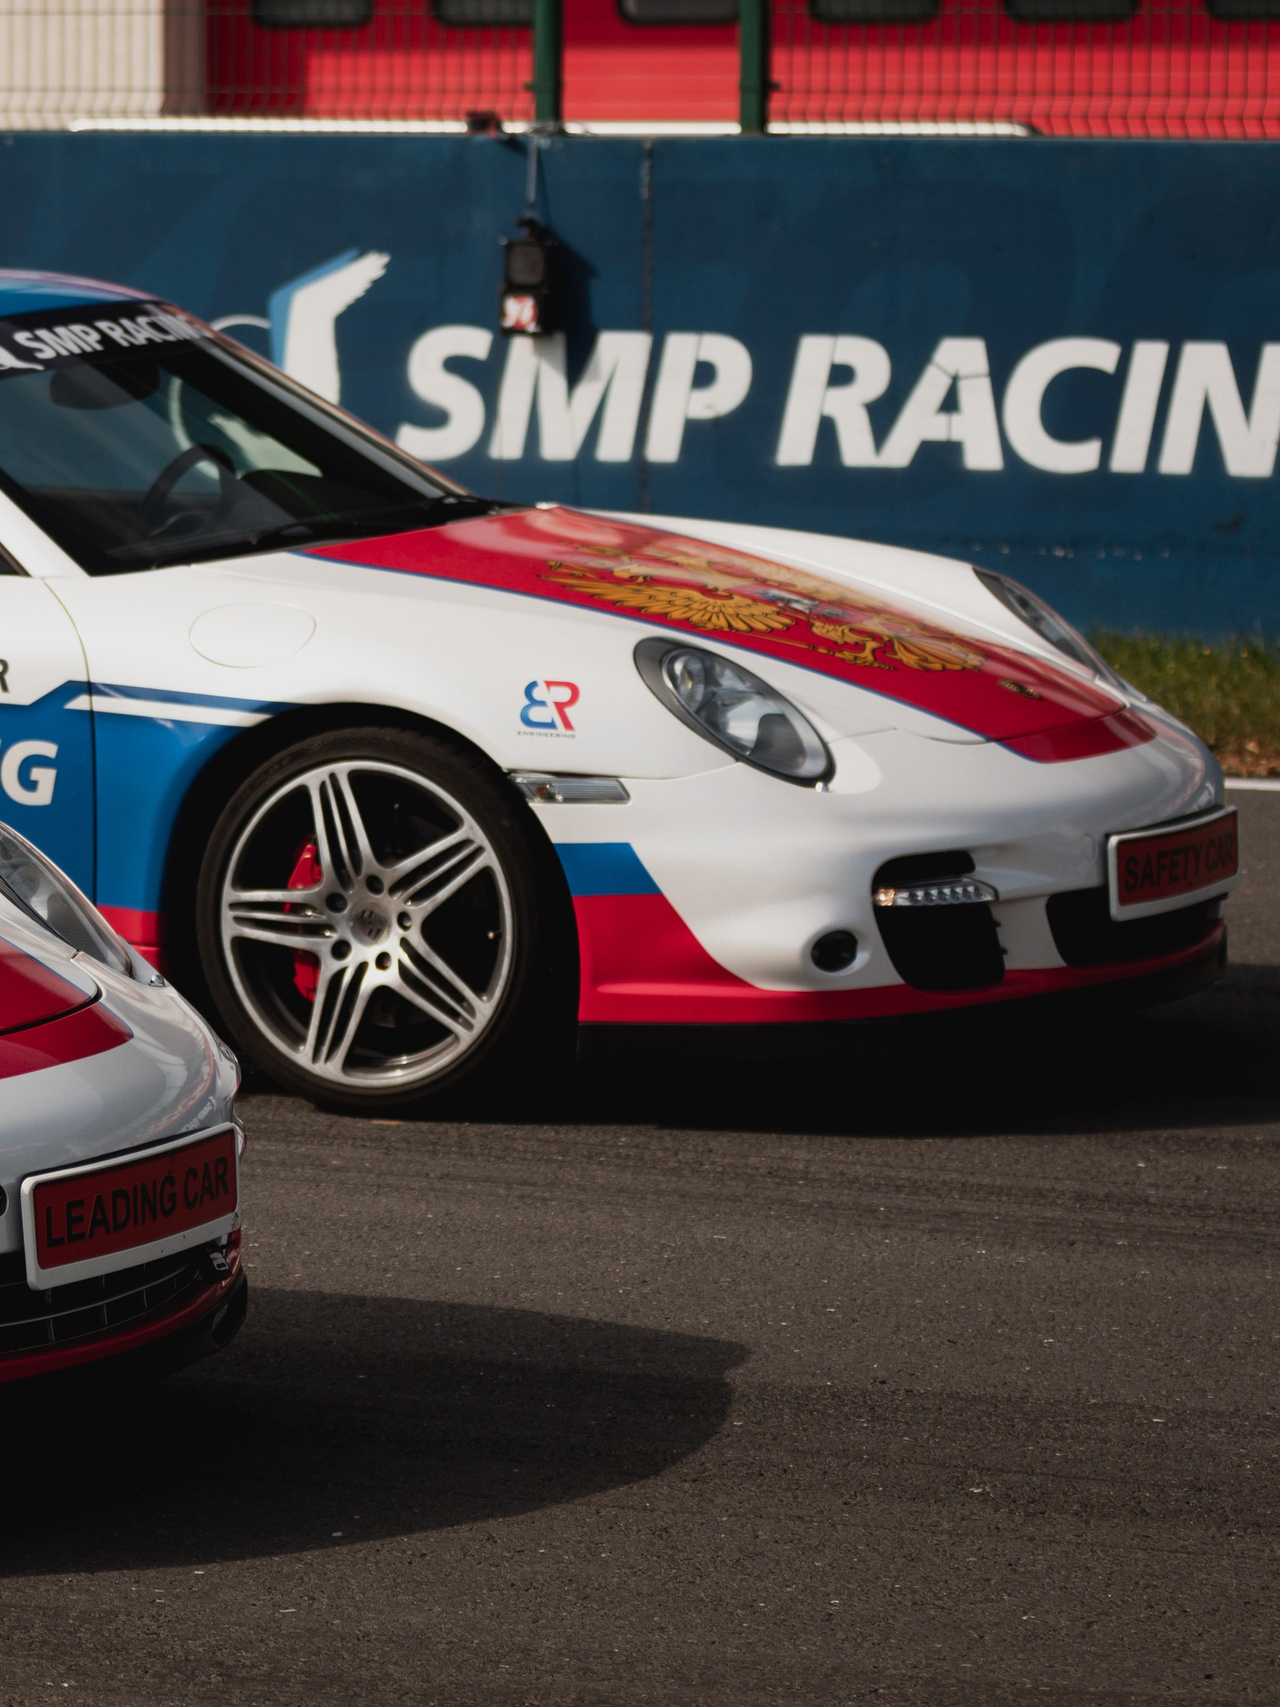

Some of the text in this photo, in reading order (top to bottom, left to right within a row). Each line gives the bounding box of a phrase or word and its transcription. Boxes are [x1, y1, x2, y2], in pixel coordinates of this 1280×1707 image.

[13, 322, 105, 360] SMP
[394, 323, 753, 464] SMP
[517, 730, 577, 740] ENGINEERING
[1124, 831, 1235, 892] SAFETY CAR
[45, 1155, 230, 1249] LEADING CAR
